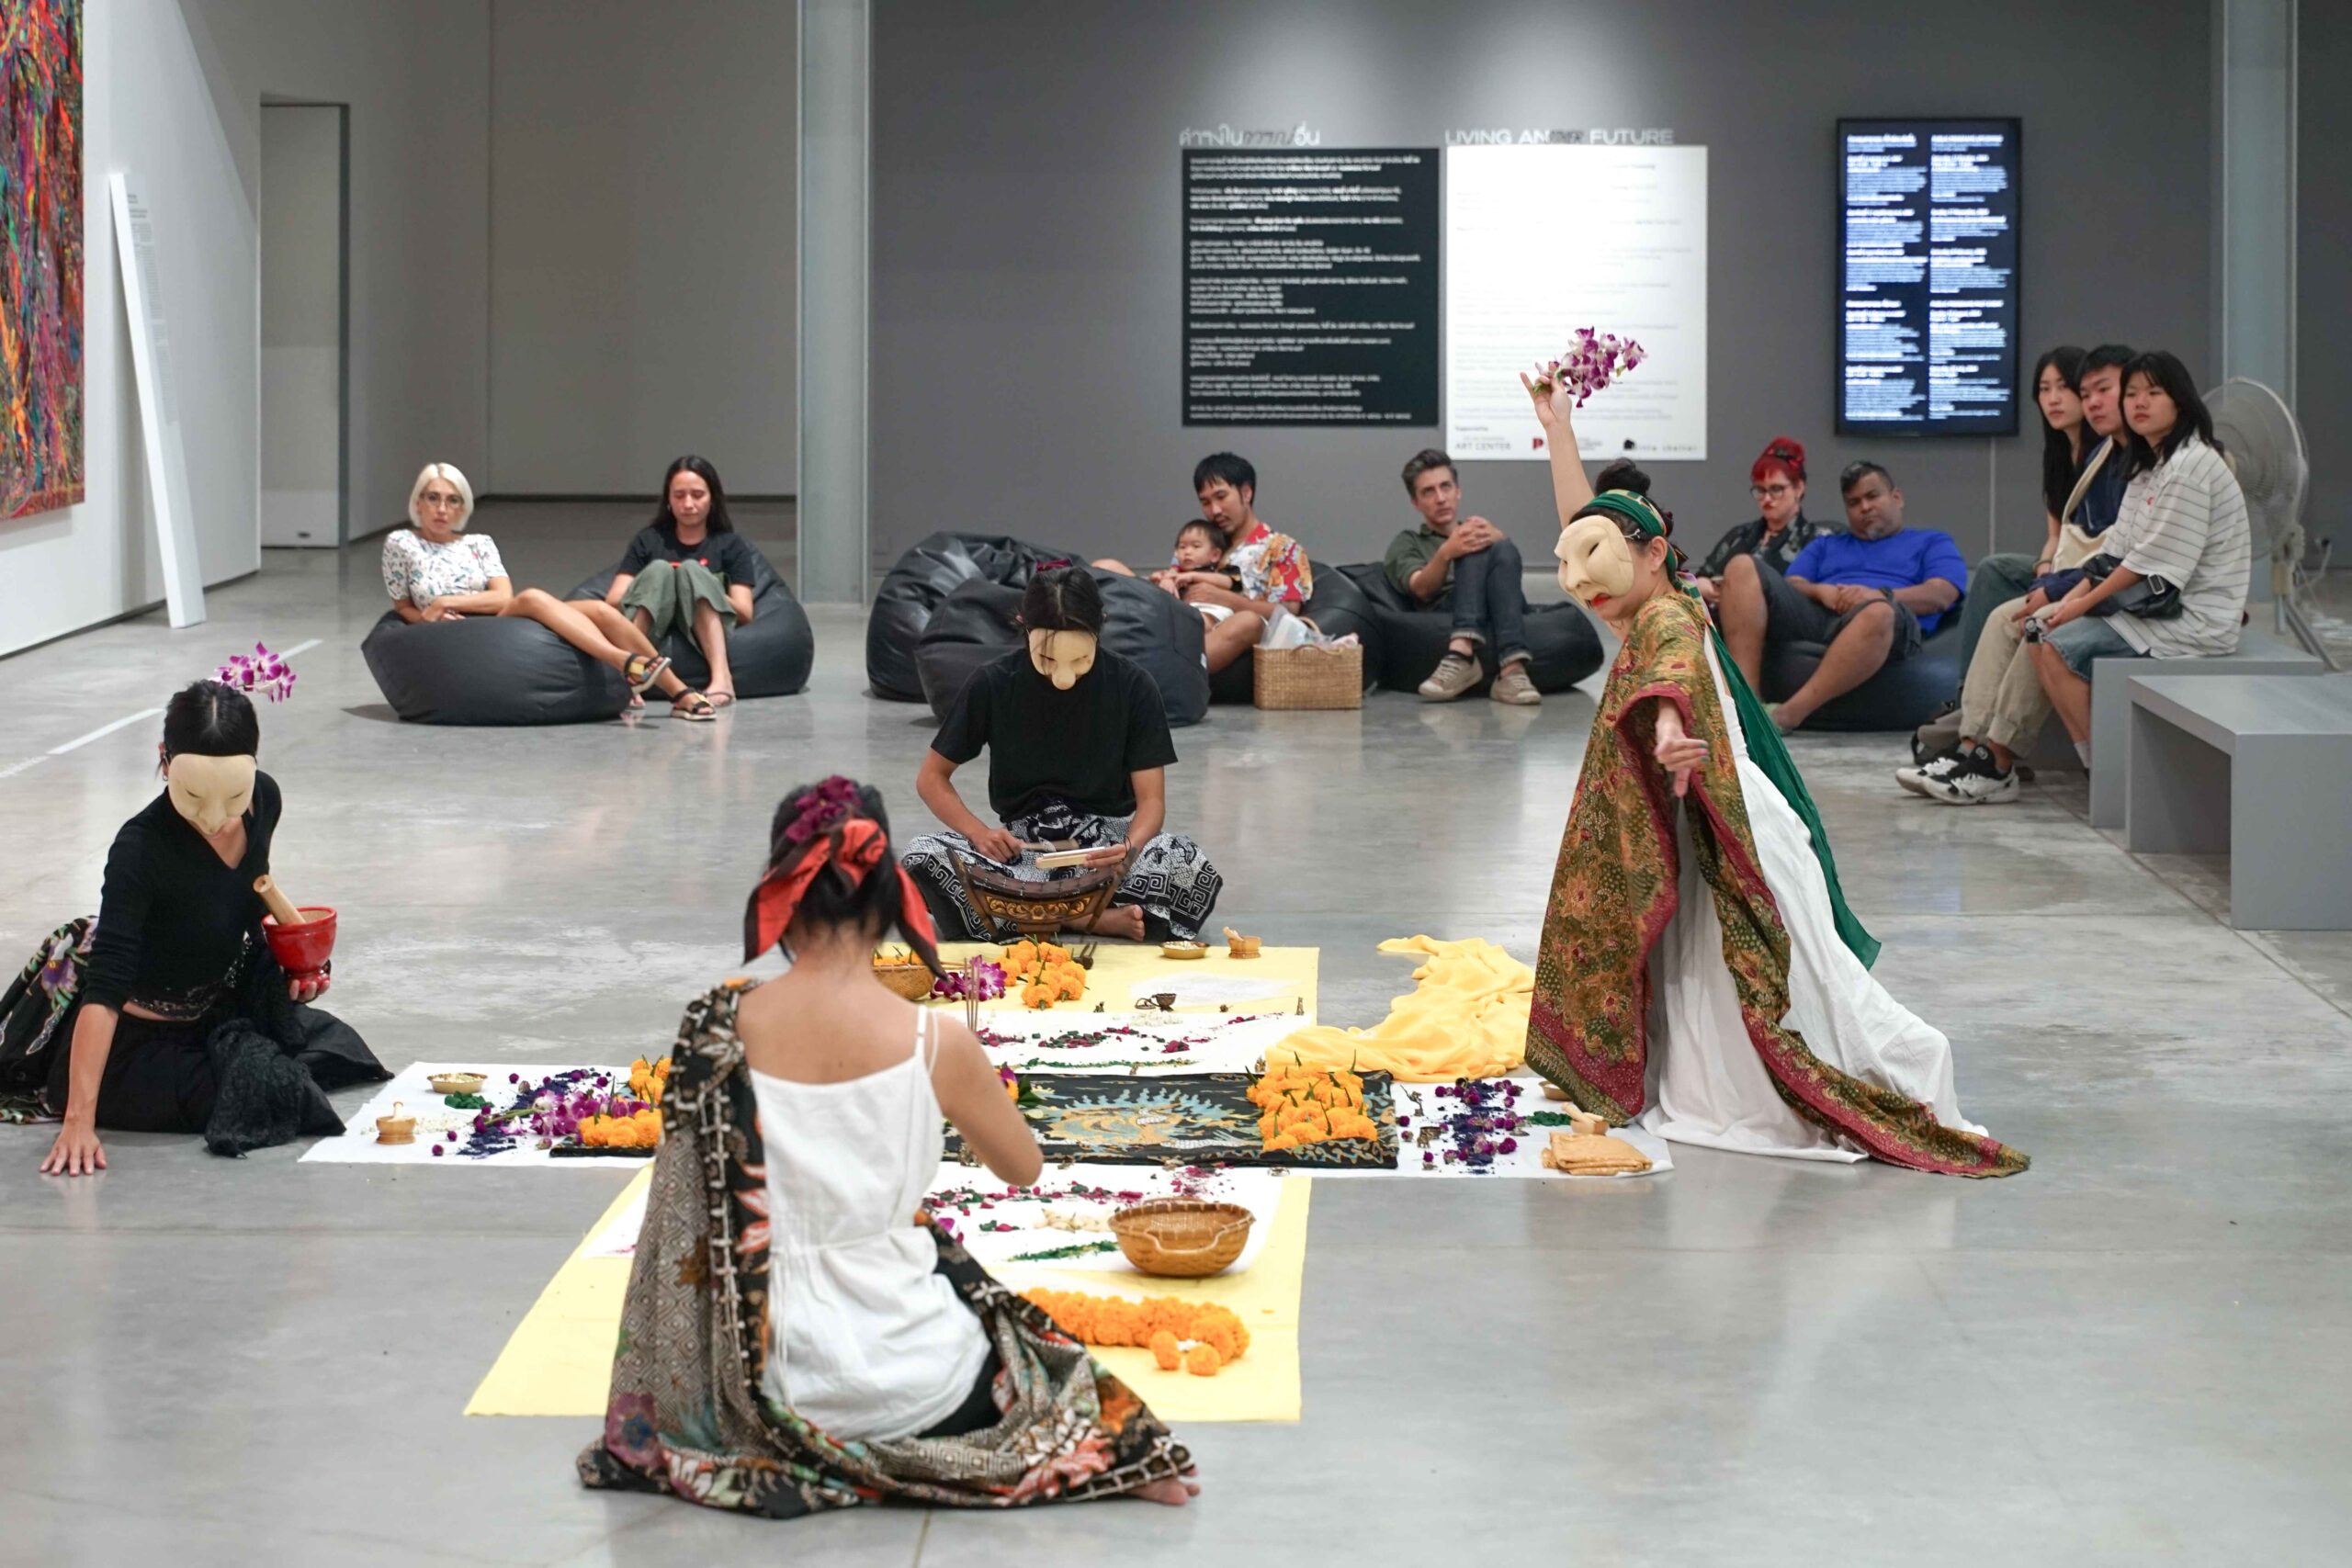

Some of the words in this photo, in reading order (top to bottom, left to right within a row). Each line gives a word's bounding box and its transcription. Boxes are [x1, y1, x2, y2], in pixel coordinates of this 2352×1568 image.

[1445, 129, 1512, 145] LIVING
[1589, 129, 1675, 145] FUTURE
[1475, 442, 1511, 451] CENTER
